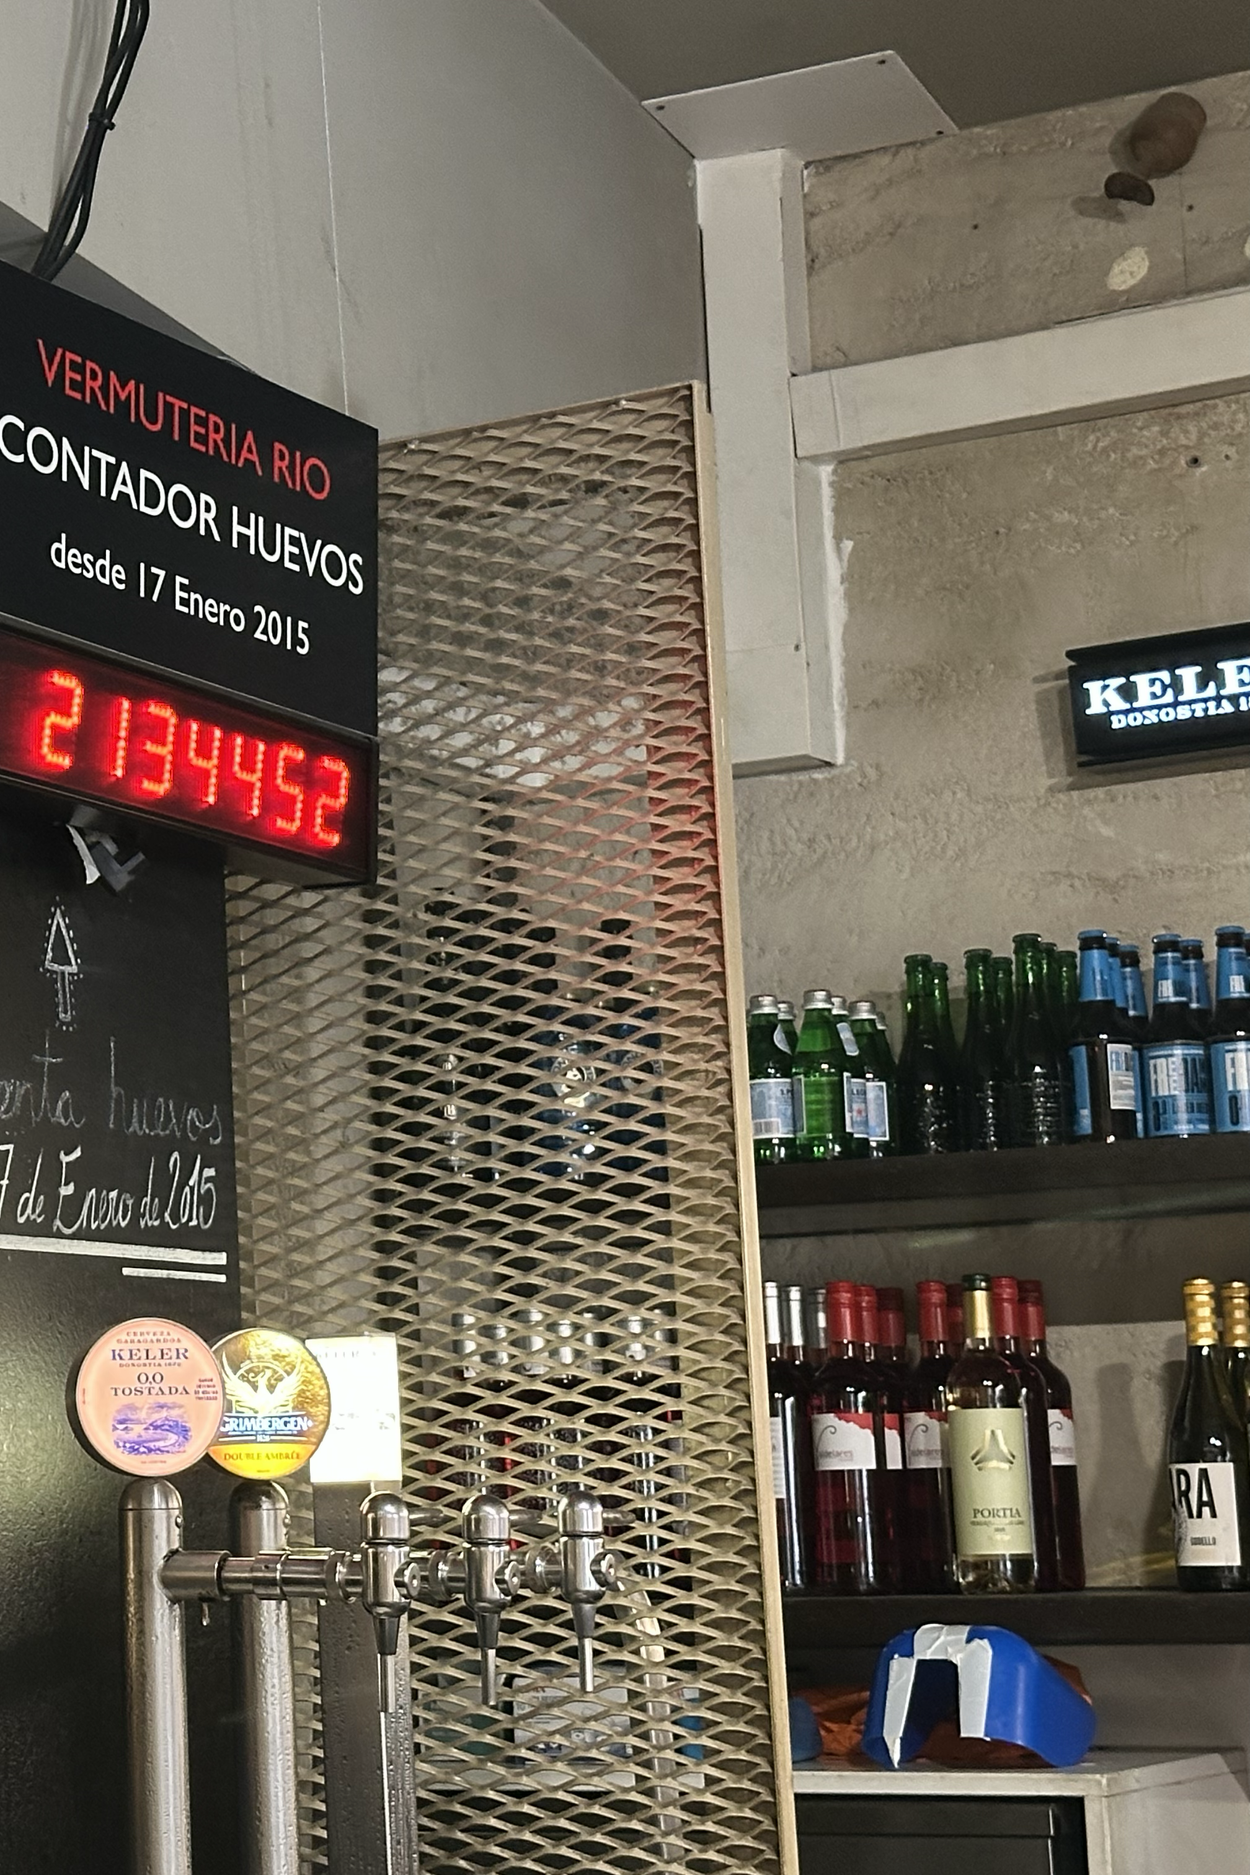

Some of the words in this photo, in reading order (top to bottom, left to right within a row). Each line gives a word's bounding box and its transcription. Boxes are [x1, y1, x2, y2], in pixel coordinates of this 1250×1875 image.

[37, 338, 263, 477] VERMUTERIA
[273, 441, 331, 500] RIO
[232, 505, 364, 596] HUEVOS
[50, 533, 126, 590] desde
[140, 562, 166, 603] 17
[175, 575, 246, 633] Enero
[253, 605, 310, 655] 2015
[1111, 699, 1235, 730] DONOSTIA
[109, 1036, 222, 1144] huevos
[17, 1148, 45, 1223] de
[53, 1145, 135, 1235] Enero
[140, 1157, 160, 1229] de
[164, 1151, 217, 1231] 2015
[110, 1347, 189, 1361] KELER
[126, 1330, 171, 1338] CERVEZA
[110, 1385, 190, 1397] TOSTADA
[220, 1416, 309, 1432] GRIMBERGEN
[972, 1507, 1023, 1519] PORTIA
[1169, 1467, 1218, 1519] RA
